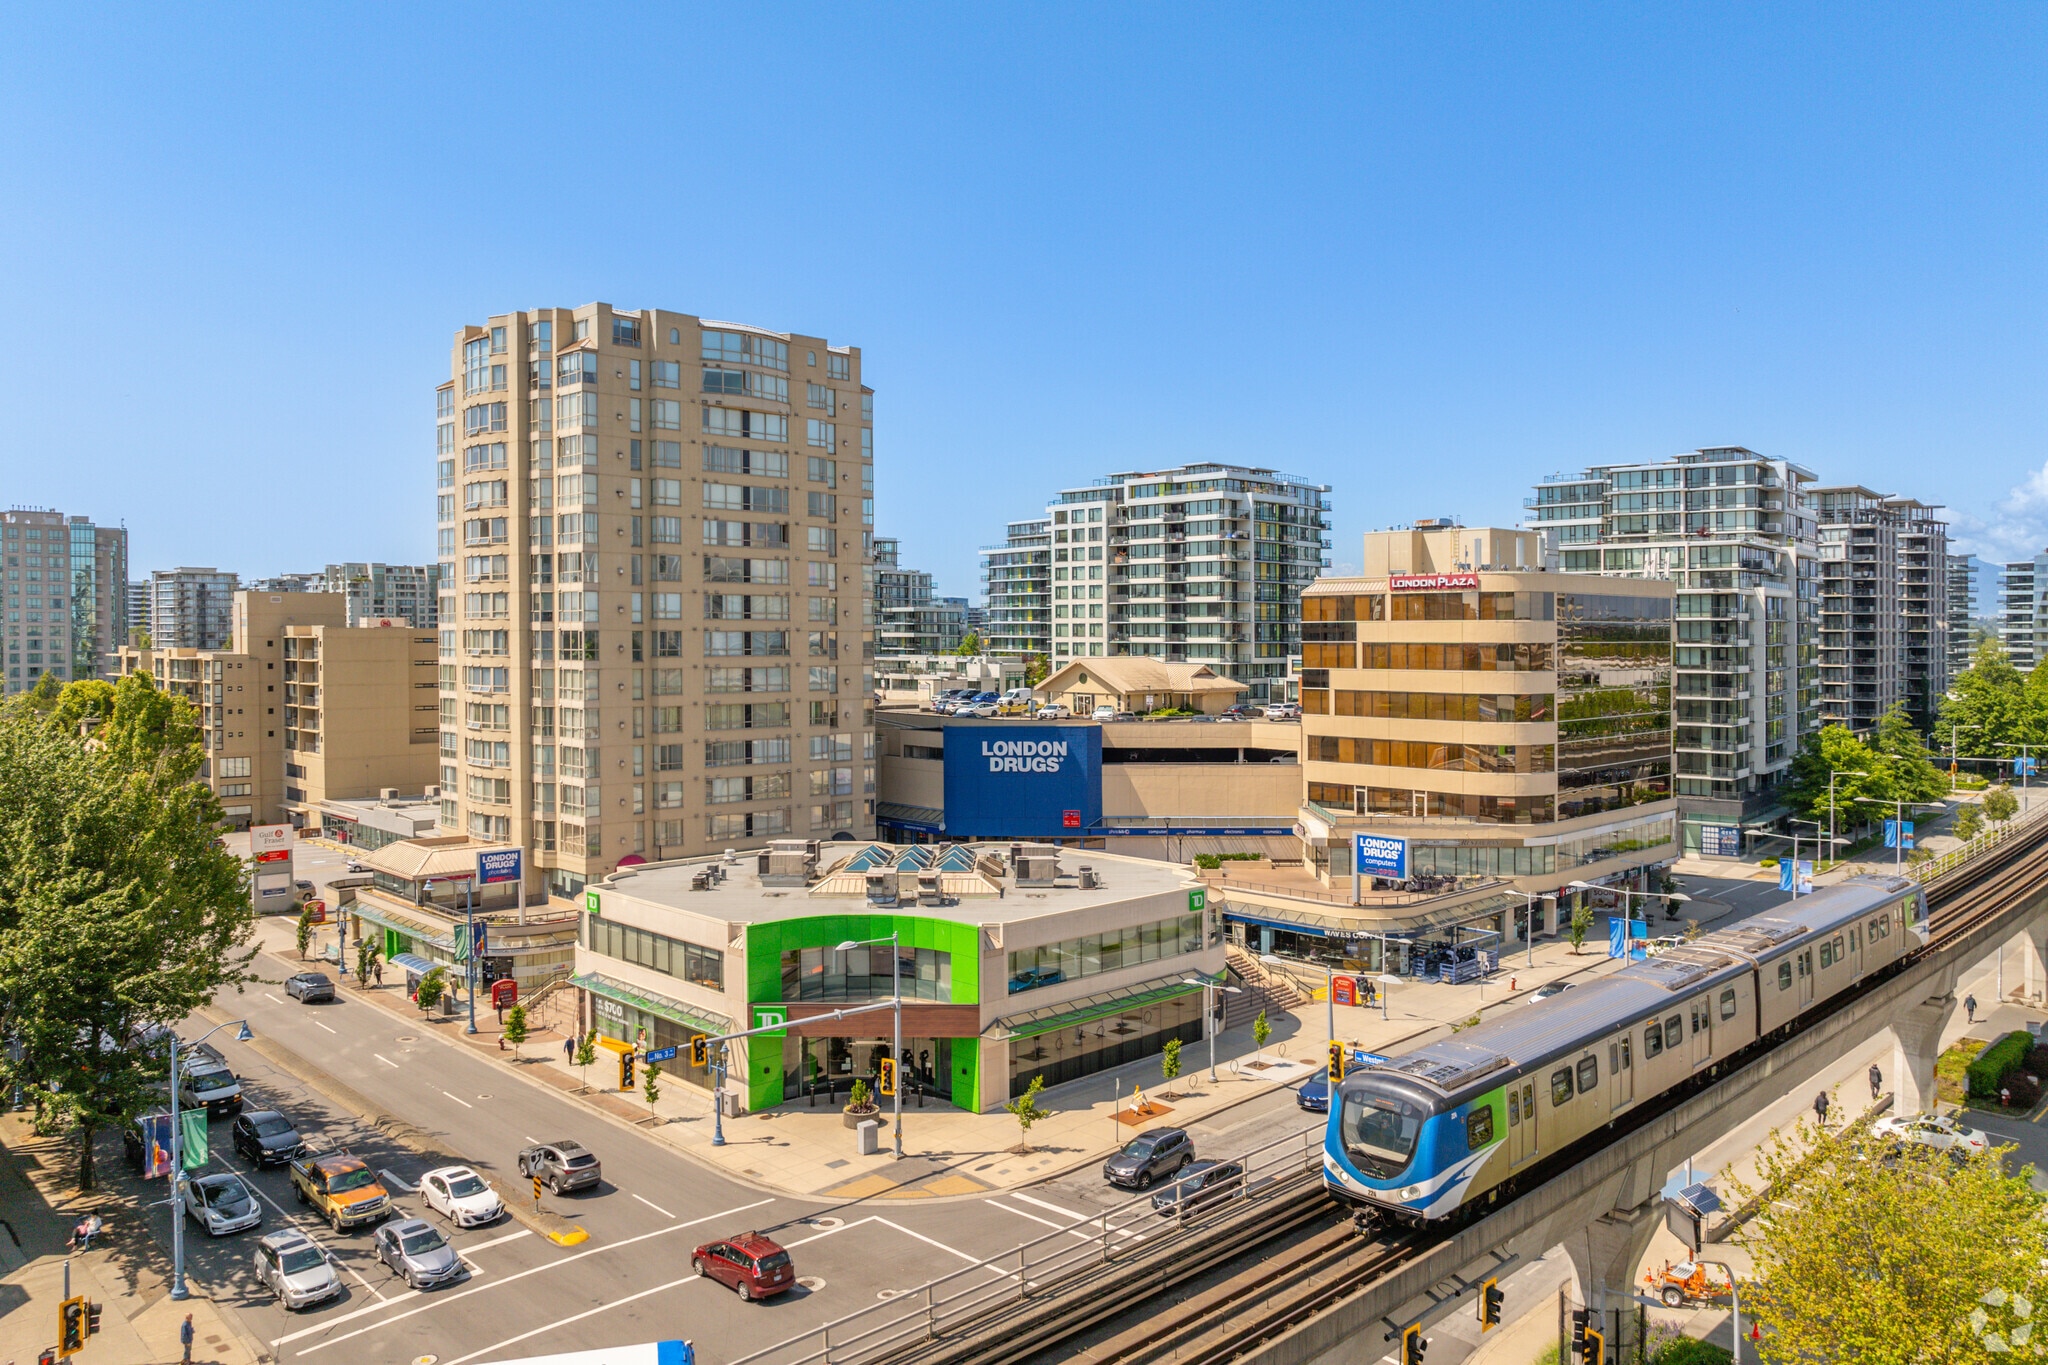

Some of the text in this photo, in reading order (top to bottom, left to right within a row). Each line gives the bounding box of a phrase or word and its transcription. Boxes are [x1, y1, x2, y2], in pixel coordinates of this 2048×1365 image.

[1391, 577, 1475, 588] LONDON PLAZA
[982, 741, 1067, 756] LONDON
[990, 757, 1060, 772] DRUGS
[1360, 837, 1402, 851] LONDON
[482, 852, 518, 863] LONDON
[1363, 847, 1398, 859] DRUGS
[485, 860, 515, 870] DRUGS
[1365, 858, 1396, 867] computers
[1377, 868, 1399, 877] OPEN
[588, 896, 597, 908] TD
[1191, 894, 1203, 907] TD
[1324, 930, 1351, 938] WAVES
[605, 1000, 623, 1017] $700
[756, 1012, 783, 1031] TD
